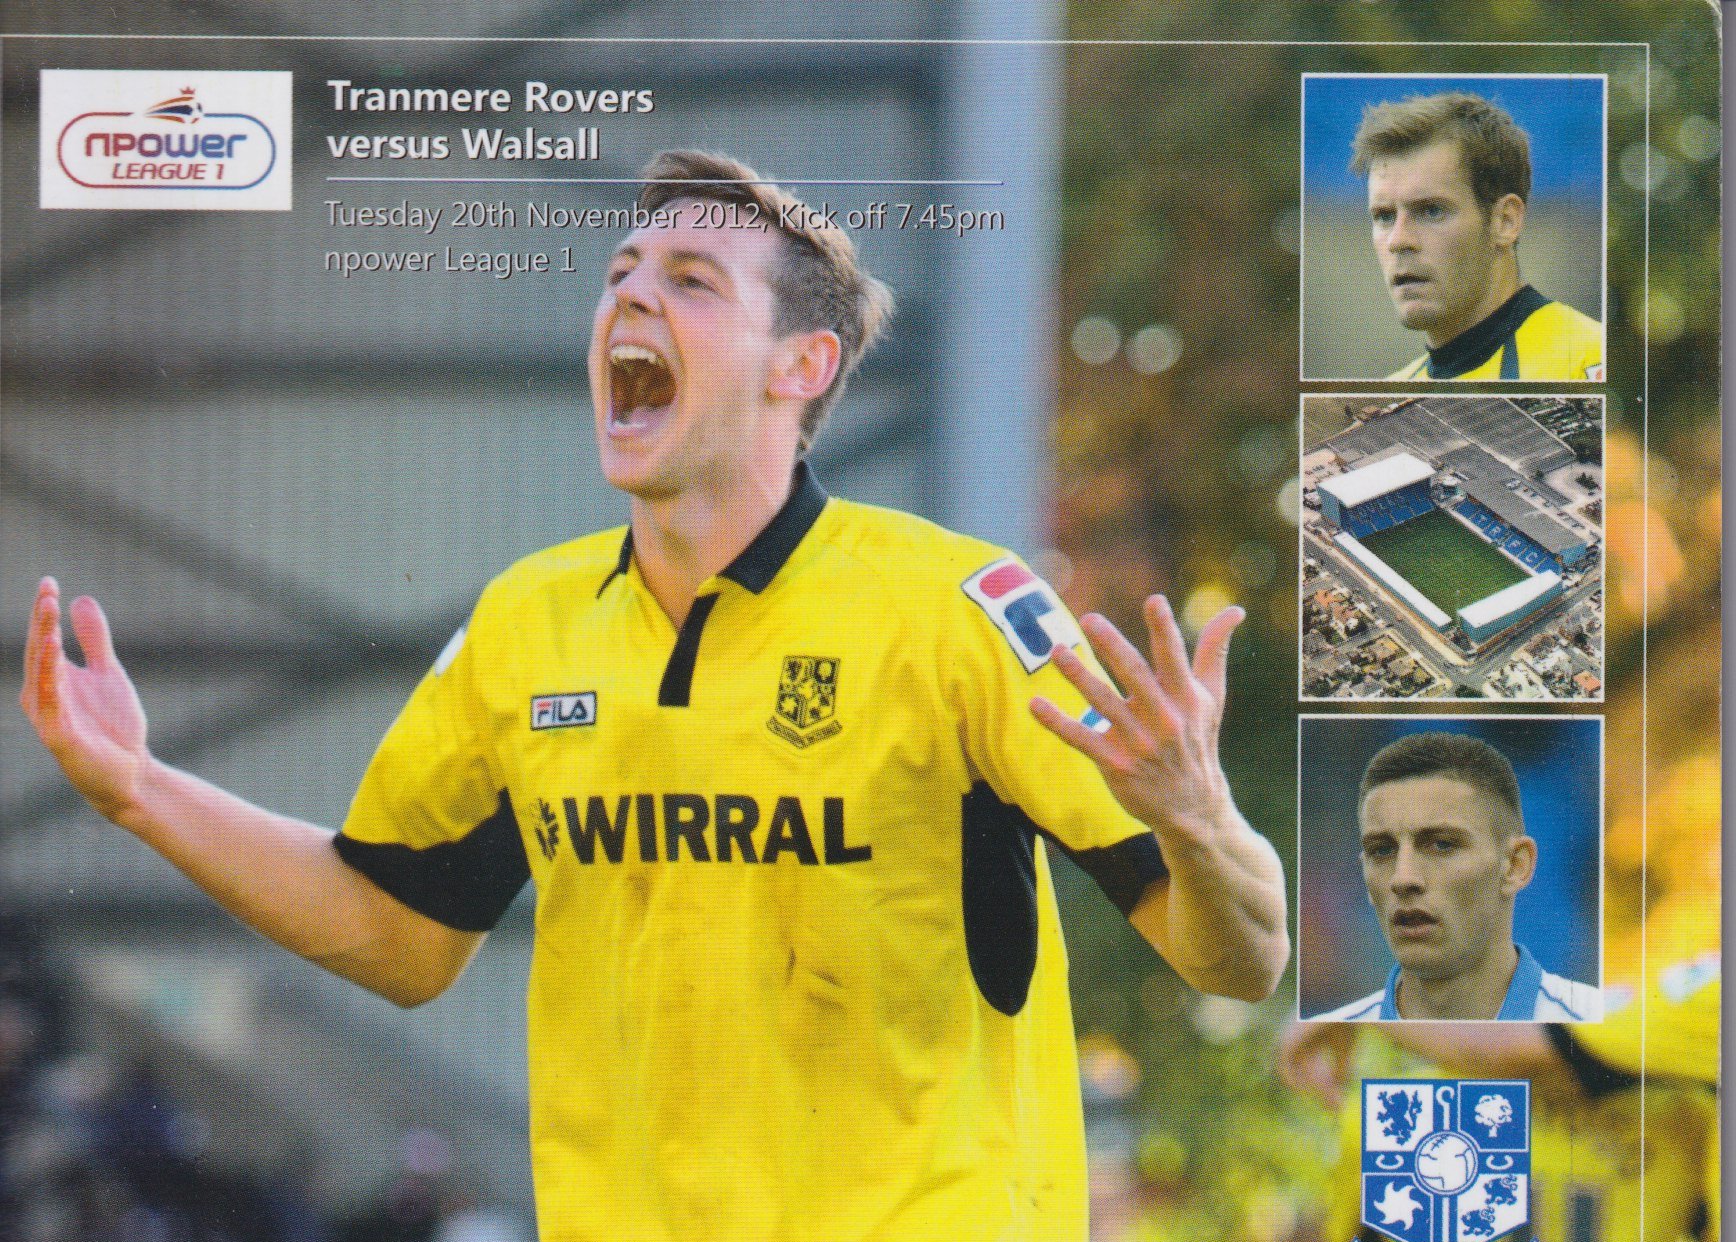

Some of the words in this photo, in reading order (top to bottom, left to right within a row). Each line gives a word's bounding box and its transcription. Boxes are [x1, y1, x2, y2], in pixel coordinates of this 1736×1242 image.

[327, 79, 511, 113] Tranmere
[526, 80, 655, 114] Rovers
[85, 133, 248, 159] npower
[327, 135, 451, 160] versus
[462, 128, 601, 161] Walsall
[112, 163, 208, 181] LEAGUE
[215, 163, 225, 180] 1
[325, 202, 443, 233] Tuesday
[452, 201, 518, 228] 20th
[528, 202, 682, 230] November
[692, 202, 770, 233] 2012,
[779, 202, 839, 230] Kick
[847, 202, 888, 230] off
[898, 203, 1005, 237] 7.45pm
[325, 247, 436, 278] npower
[446, 247, 550, 280] League
[562, 248, 577, 273] 1
[537, 698, 588, 724] FILA
[562, 793, 873, 866] WIRRAL
